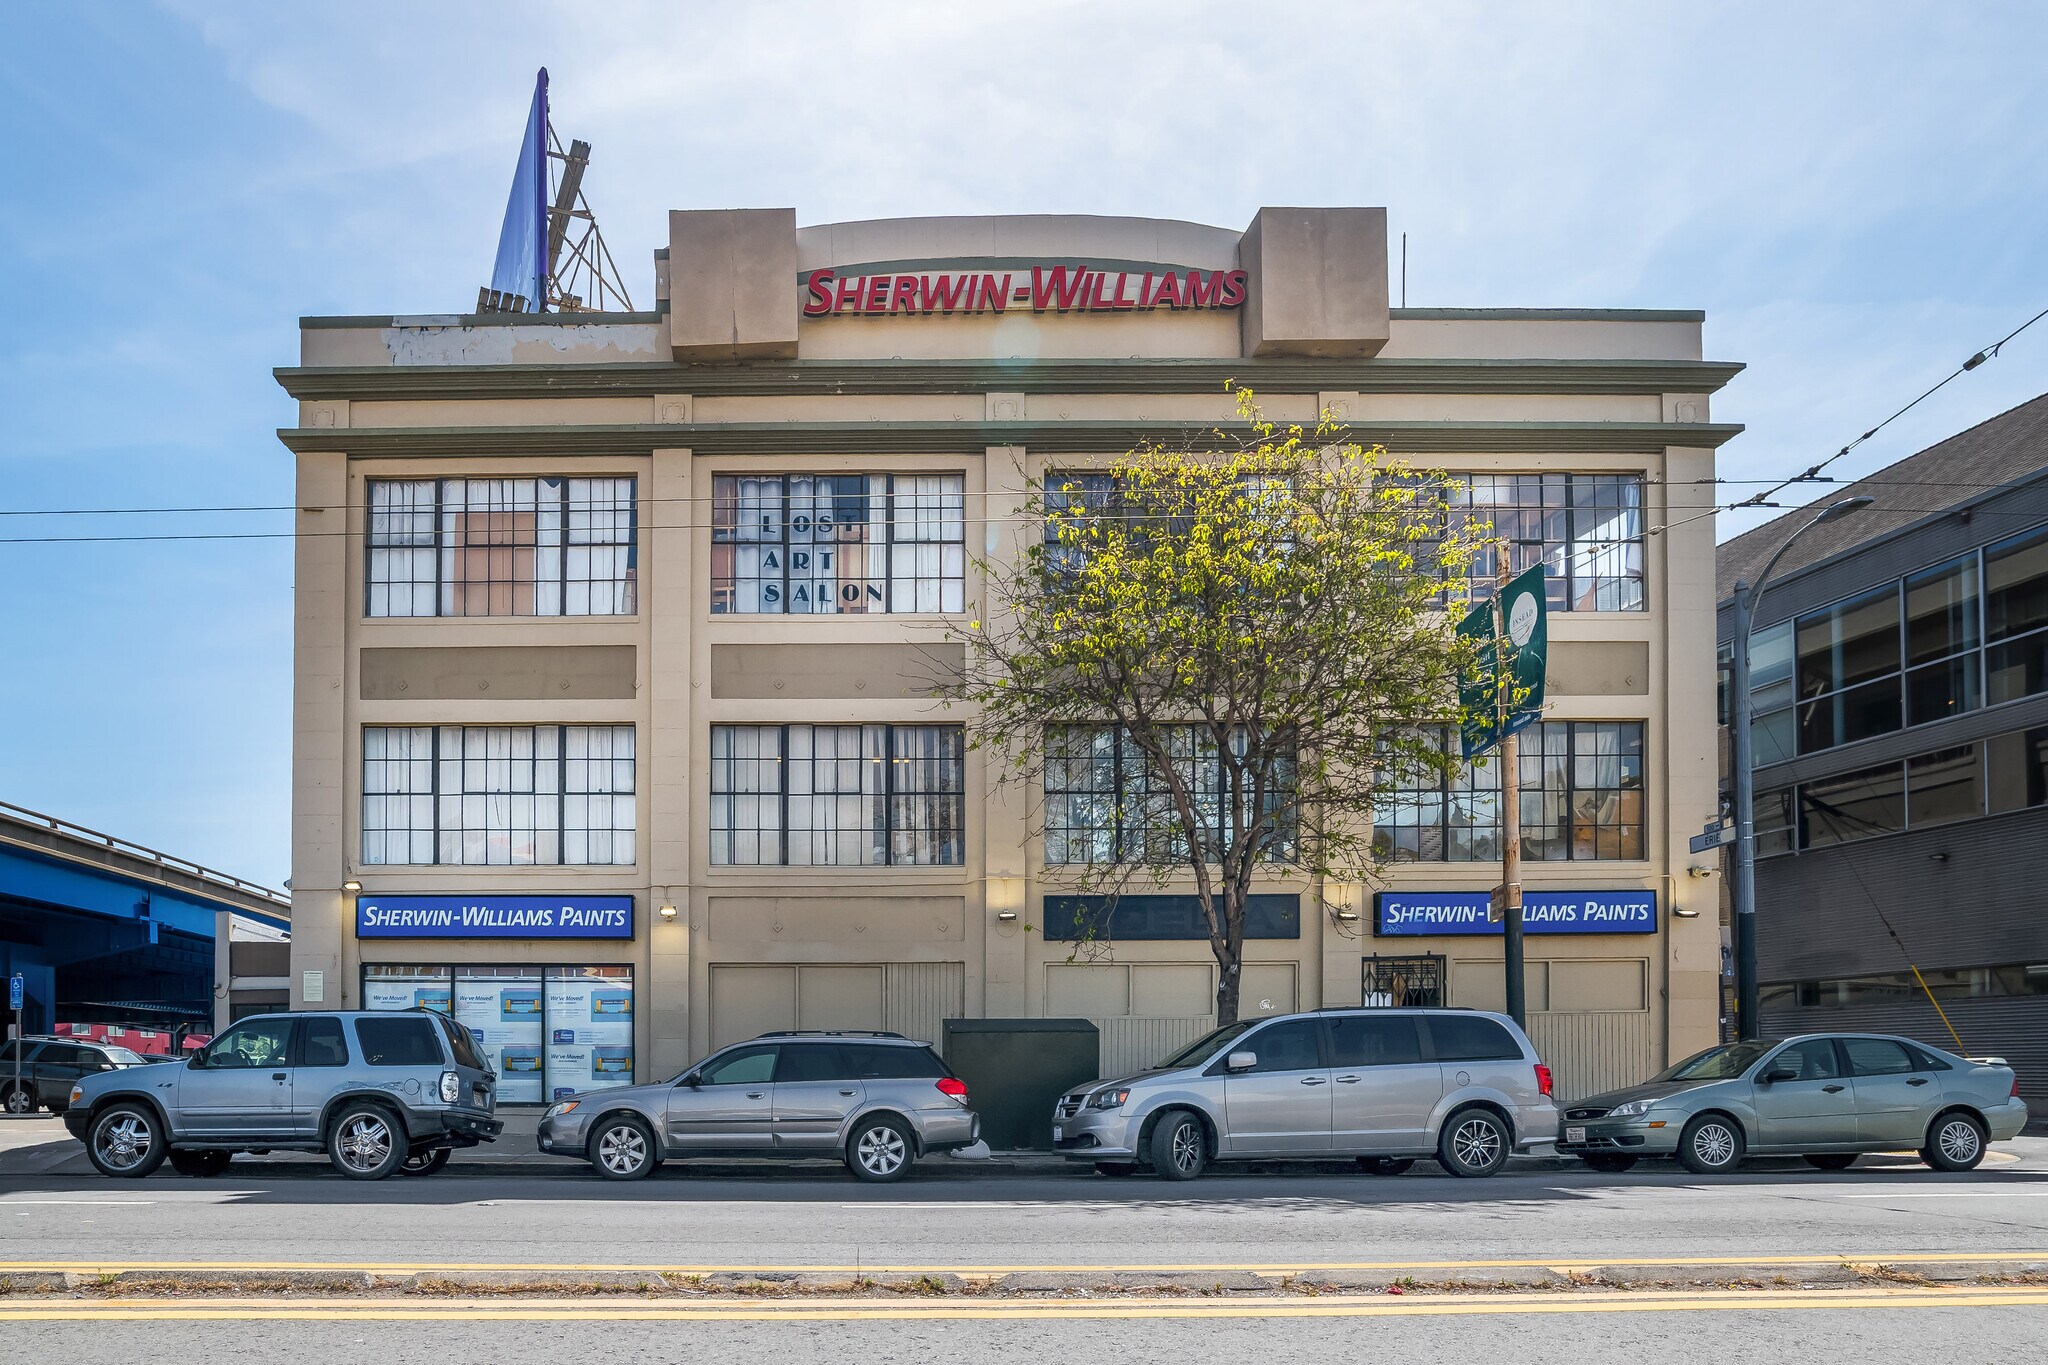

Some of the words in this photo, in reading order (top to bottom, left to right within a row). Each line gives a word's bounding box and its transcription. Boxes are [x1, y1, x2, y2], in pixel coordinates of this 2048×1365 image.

[804, 265, 1248, 317] SHERWIN-WILLIAMS
[763, 515, 856, 533] LOST
[763, 551, 834, 569] ART
[764, 584, 882, 602] SALON
[1512, 608, 1533, 628] INSEAD
[1704, 833, 1720, 846] ERIE
[364, 906, 553, 926] SHERWIN-WILLIAMS
[559, 906, 626, 926] PAINTS
[1387, 902, 1577, 923] SHERWIN-LIAMS
[1583, 901, 1649, 921] PAINTS
